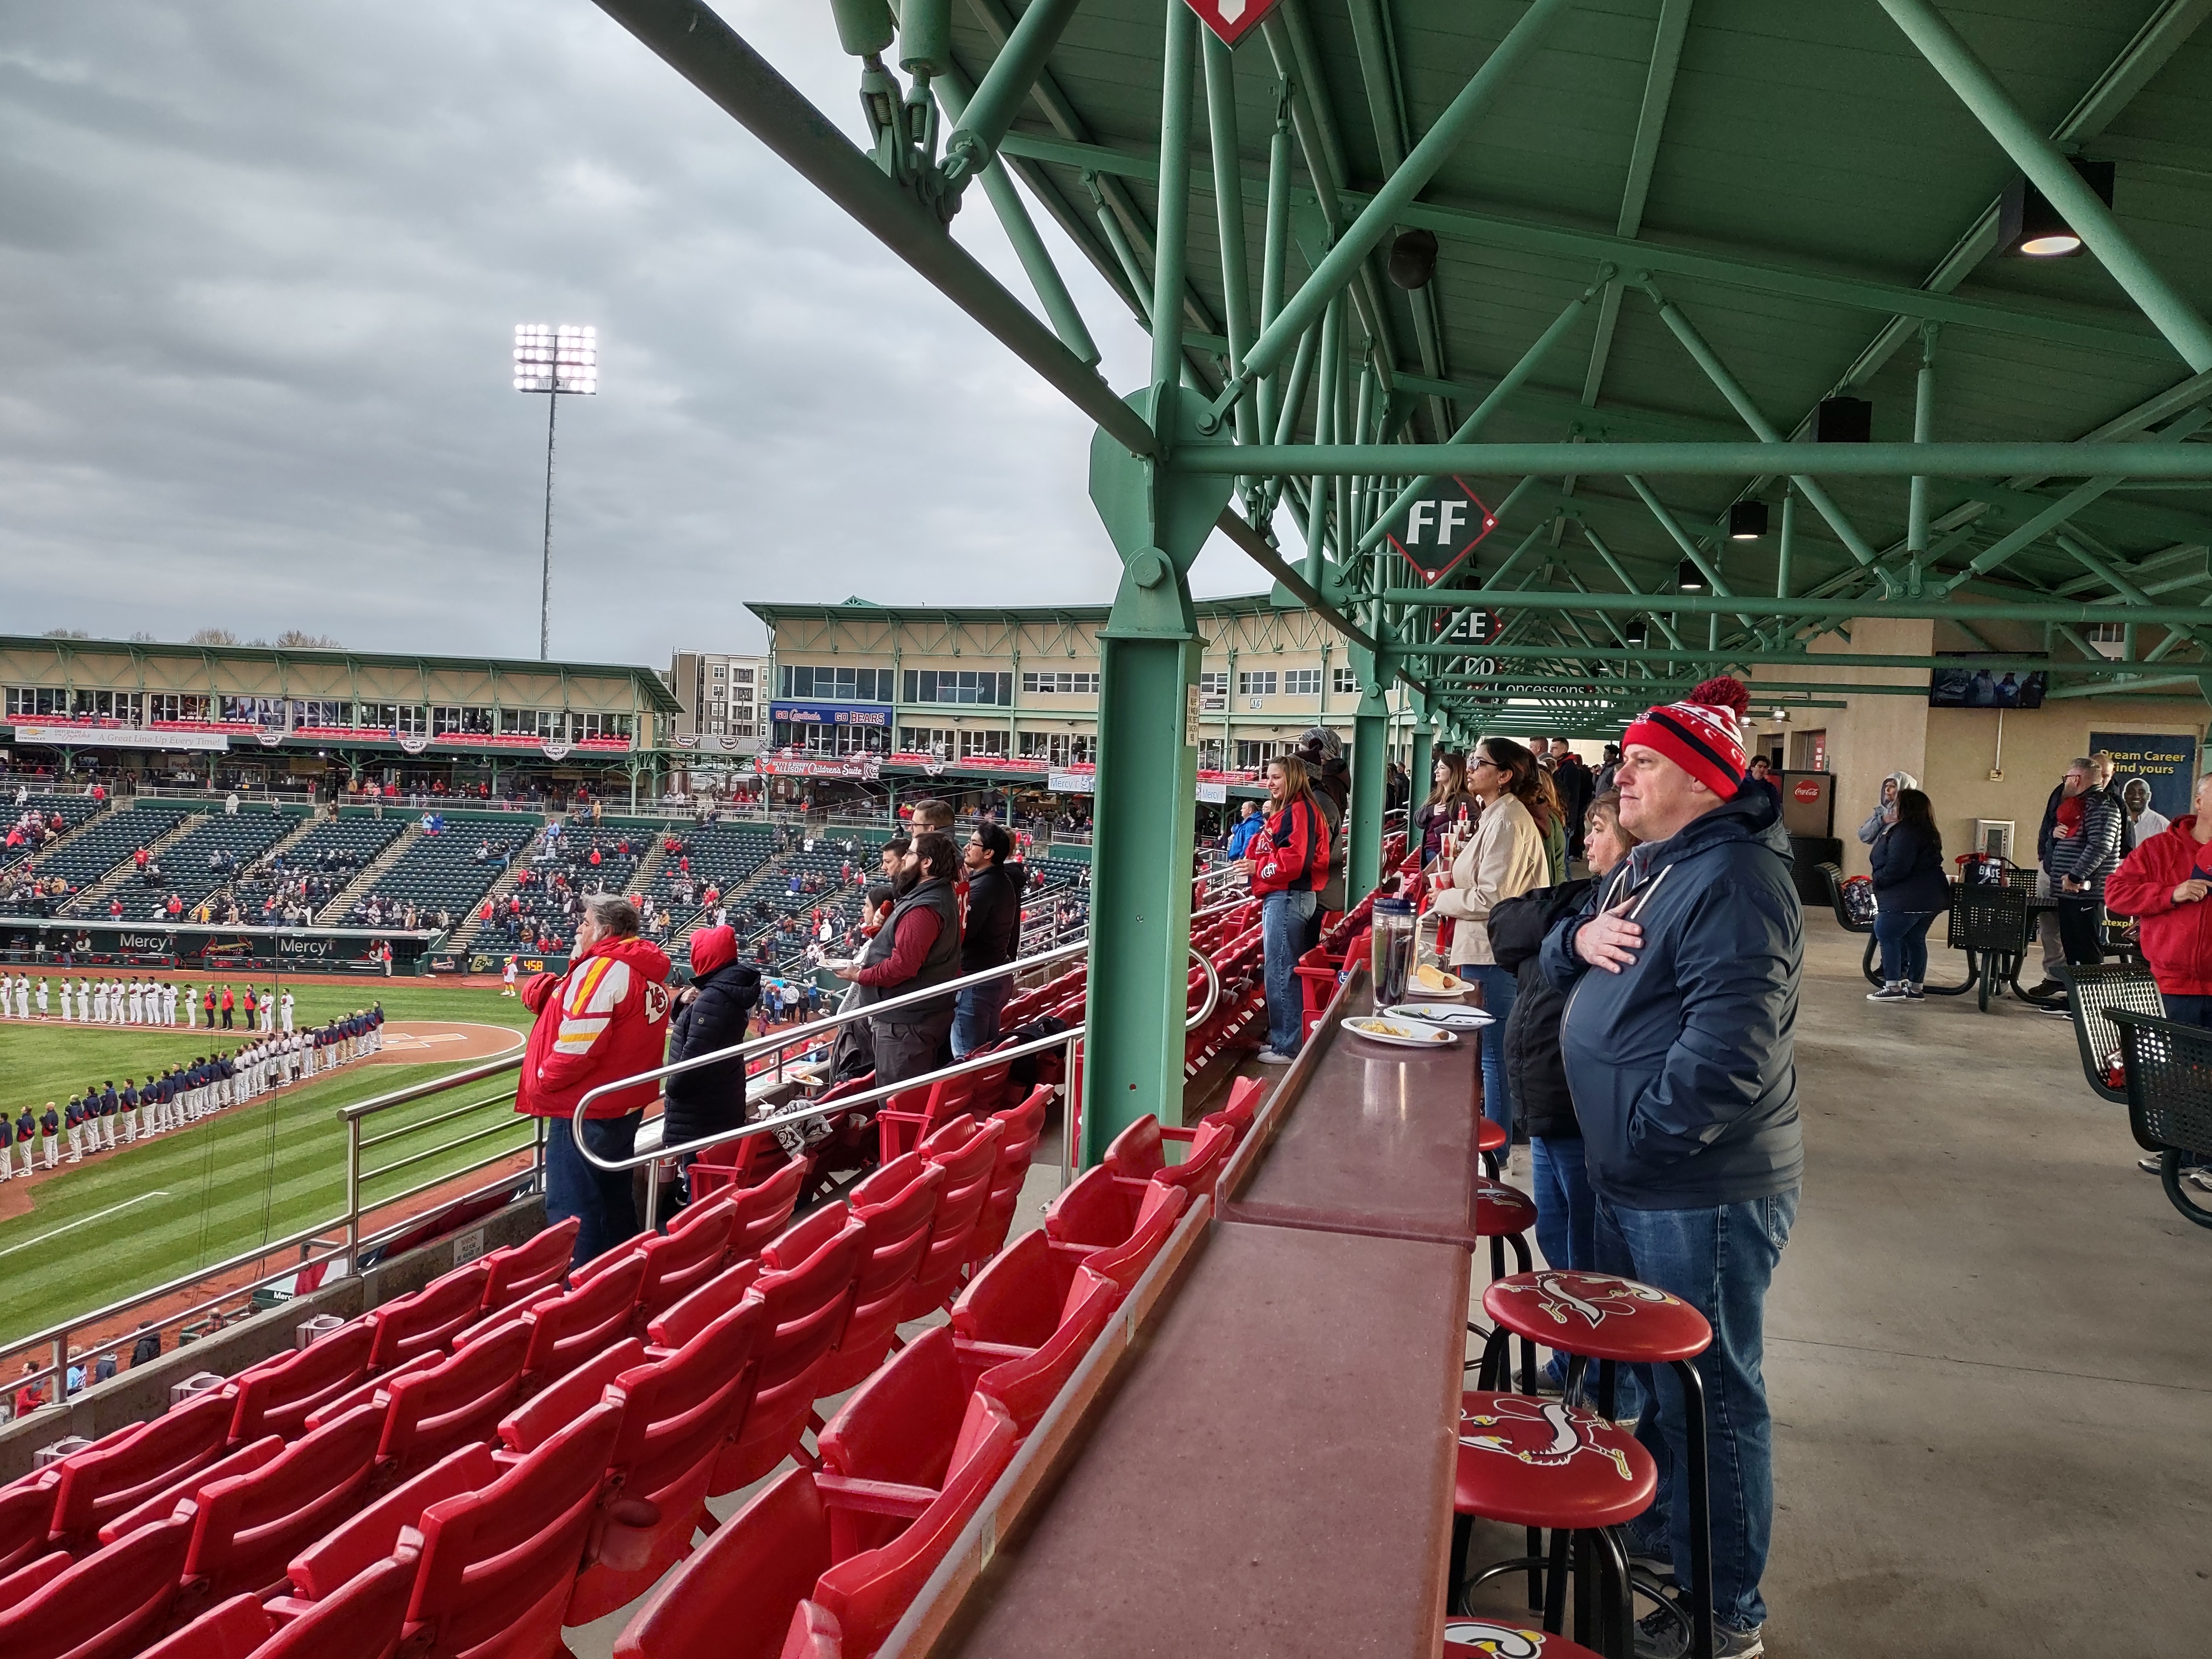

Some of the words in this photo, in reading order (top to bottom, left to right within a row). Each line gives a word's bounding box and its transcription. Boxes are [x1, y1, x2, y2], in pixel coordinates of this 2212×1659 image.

[1406, 500, 1467, 545] FF
[1451, 612, 1486, 638] EE
[1250, 698, 1262, 708] KY3
[776, 711, 787, 719] GO
[790, 708, 821, 722] Cardinals
[835, 712, 848, 721] GO
[850, 711, 885, 725] BEARS
[107, 734, 131, 742] Great
[134, 734, 152, 743] Line
[155, 735, 166, 744] Up
[169, 737, 194, 745] Every
[196, 737, 220, 745] Time!
[2145, 751, 2186, 762] Career
[807, 763, 841, 775] Children's
[842, 763, 862, 775] Suite
[2140, 766, 2174, 775] yours
[1051, 779, 1073, 789] Mercy
[1202, 789, 1220, 801] Mercy
[1979, 865, 2001, 878] BASE
[120, 933, 168, 951] Mercy
[280, 938, 327, 956] Mercy
[524, 960, 543, 972] 458
[650, 987, 666, 1014] KC
[273, 1291, 292, 1301] Merc
